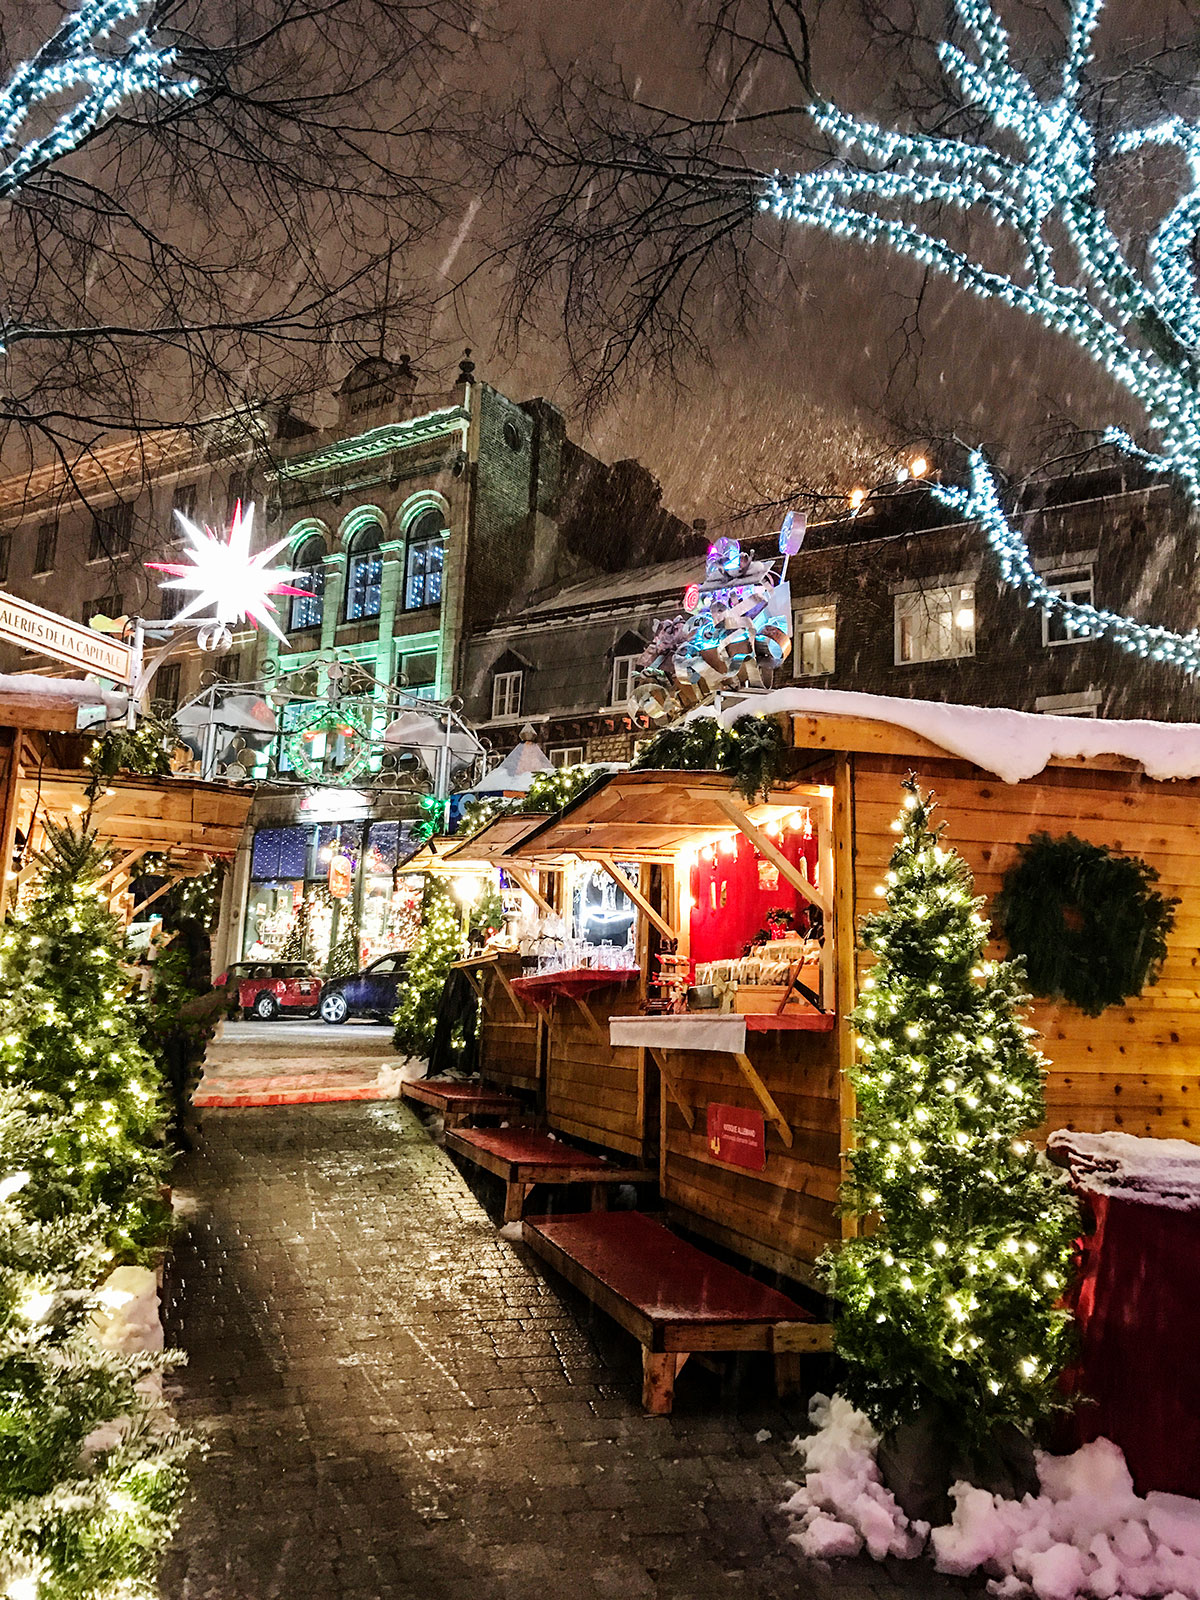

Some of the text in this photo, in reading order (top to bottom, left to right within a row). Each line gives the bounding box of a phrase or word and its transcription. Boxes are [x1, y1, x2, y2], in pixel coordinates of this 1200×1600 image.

[45, 627, 59, 643] DE
[61, 635, 74, 651] LA
[76, 642, 121, 668] CAPITALE
